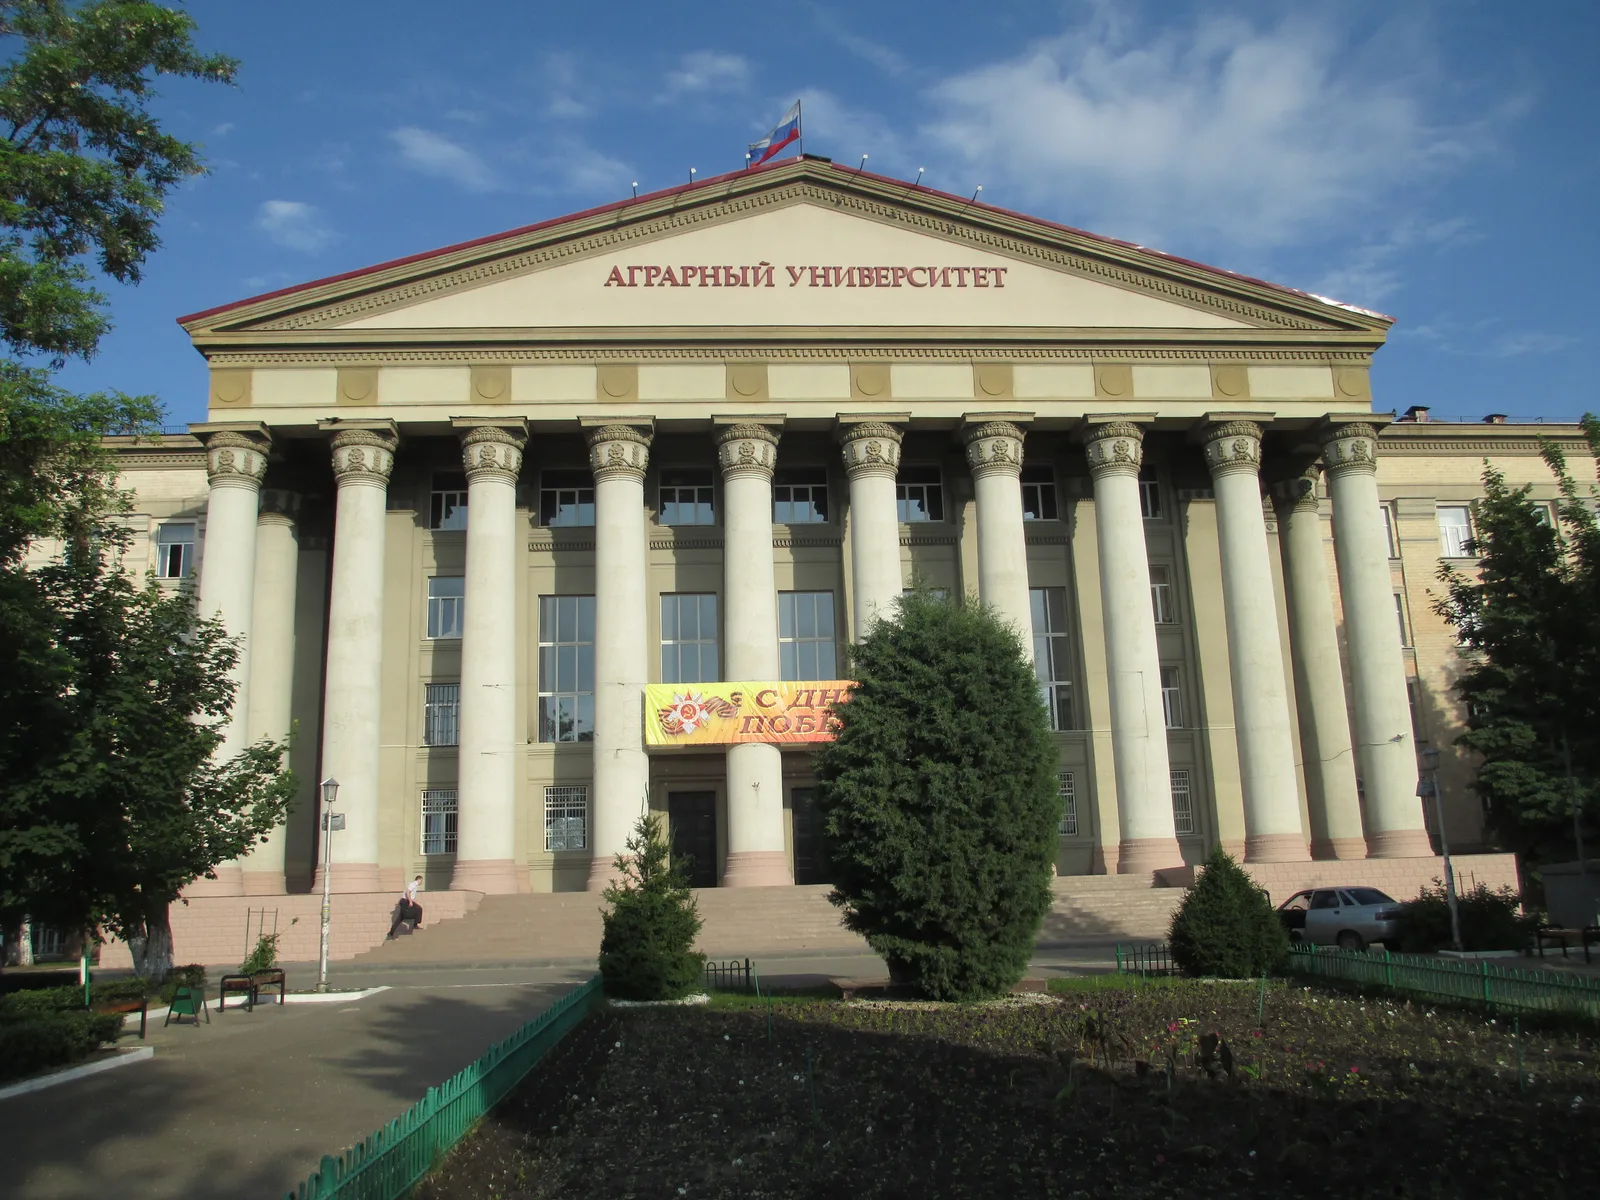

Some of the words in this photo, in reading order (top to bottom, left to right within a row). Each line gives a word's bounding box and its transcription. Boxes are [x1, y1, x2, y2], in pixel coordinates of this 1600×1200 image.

[603, 260, 776, 287] АГРАРНЫЙ
[786, 265, 1009, 288] УНИВЕРСИТЕТ
[755, 689, 779, 708] С
